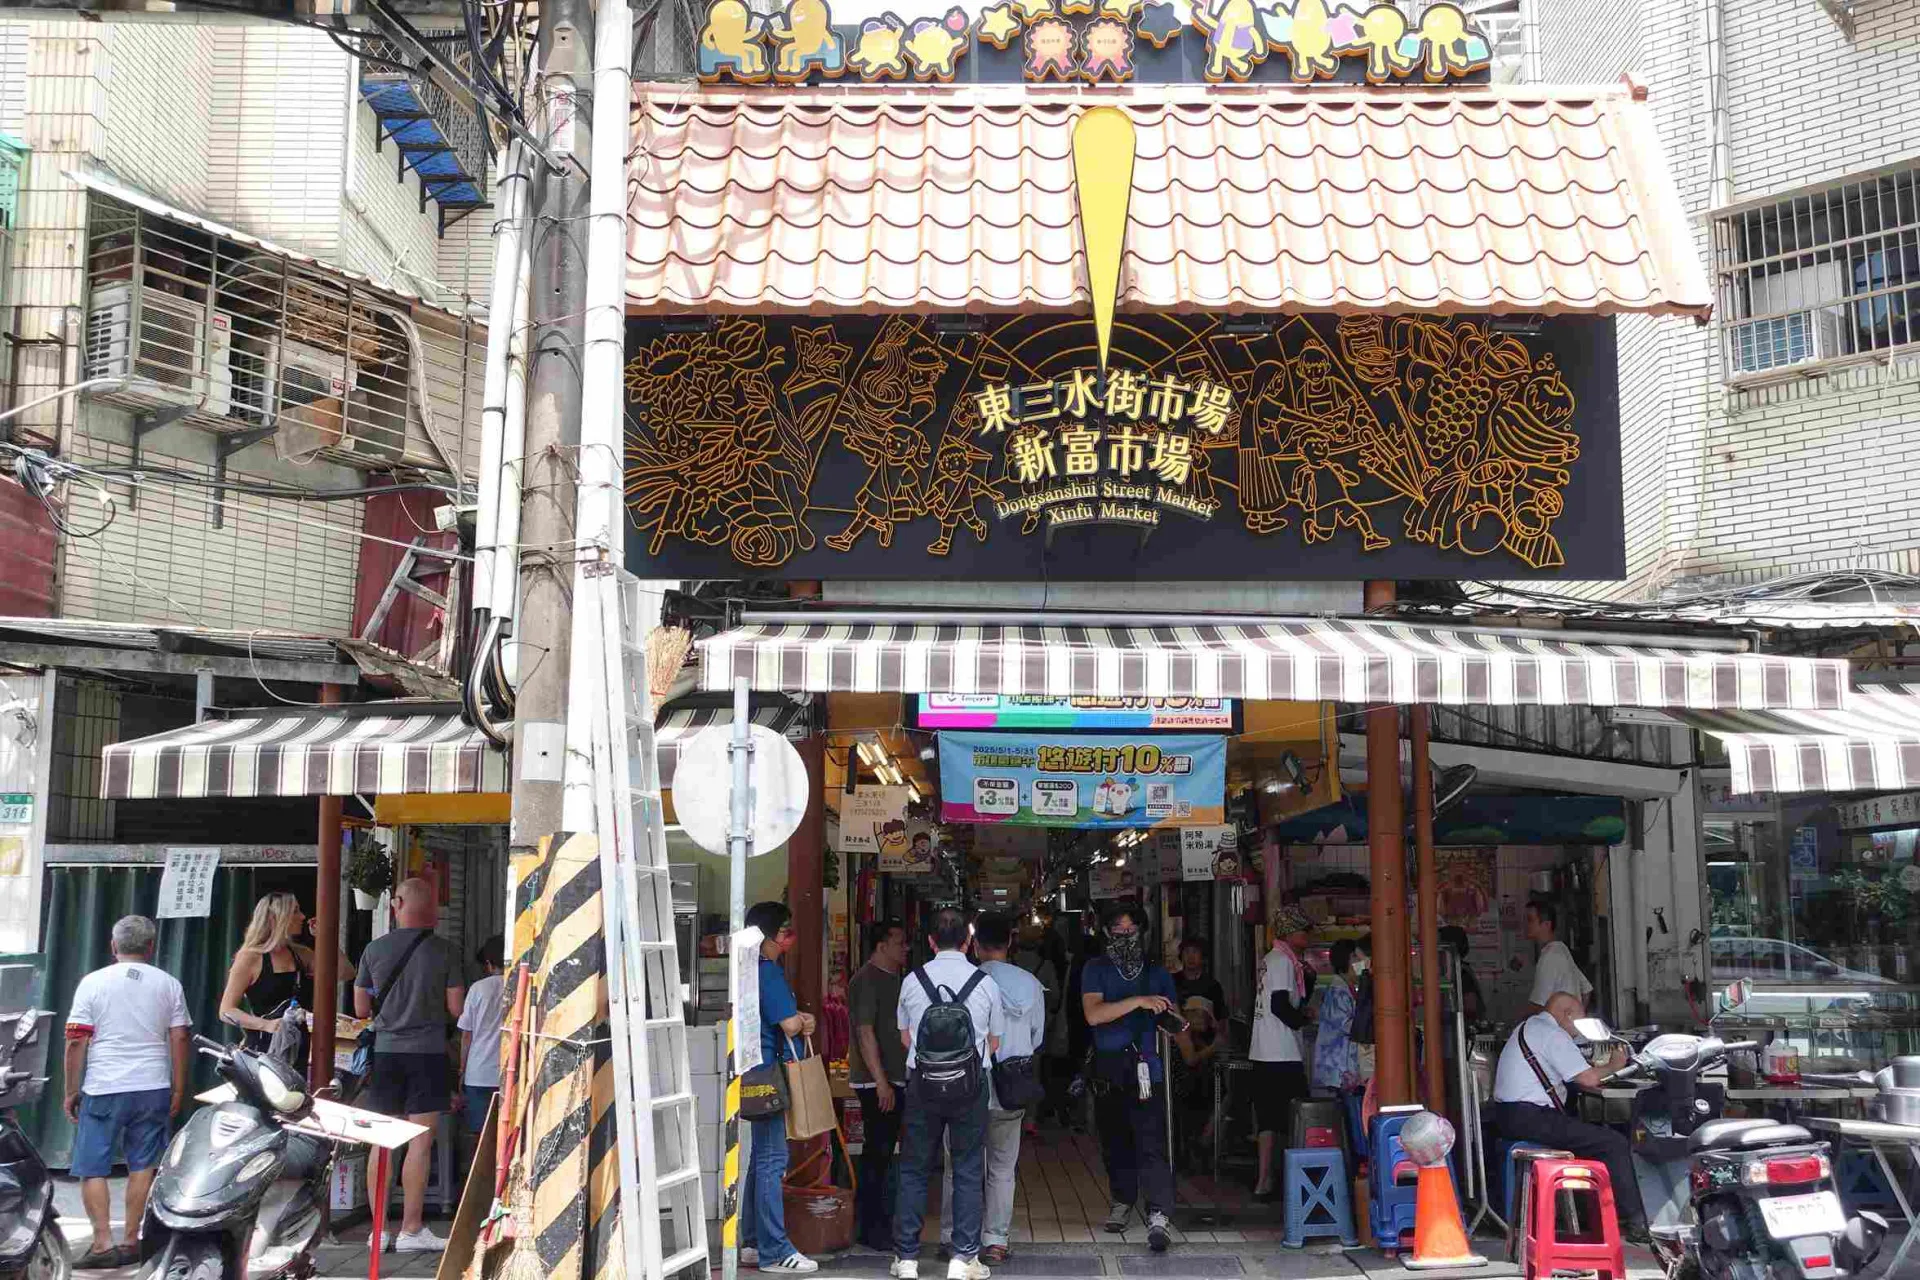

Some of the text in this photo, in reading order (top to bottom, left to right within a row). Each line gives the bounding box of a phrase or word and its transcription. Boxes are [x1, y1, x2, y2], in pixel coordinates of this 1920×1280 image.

[973, 367, 1232, 435] 東三水街市場
[1014, 425, 1195, 485] 新富市場
[997, 481, 1213, 518] Dongsanshui Street Market
[1101, 503, 1159, 524] Market
